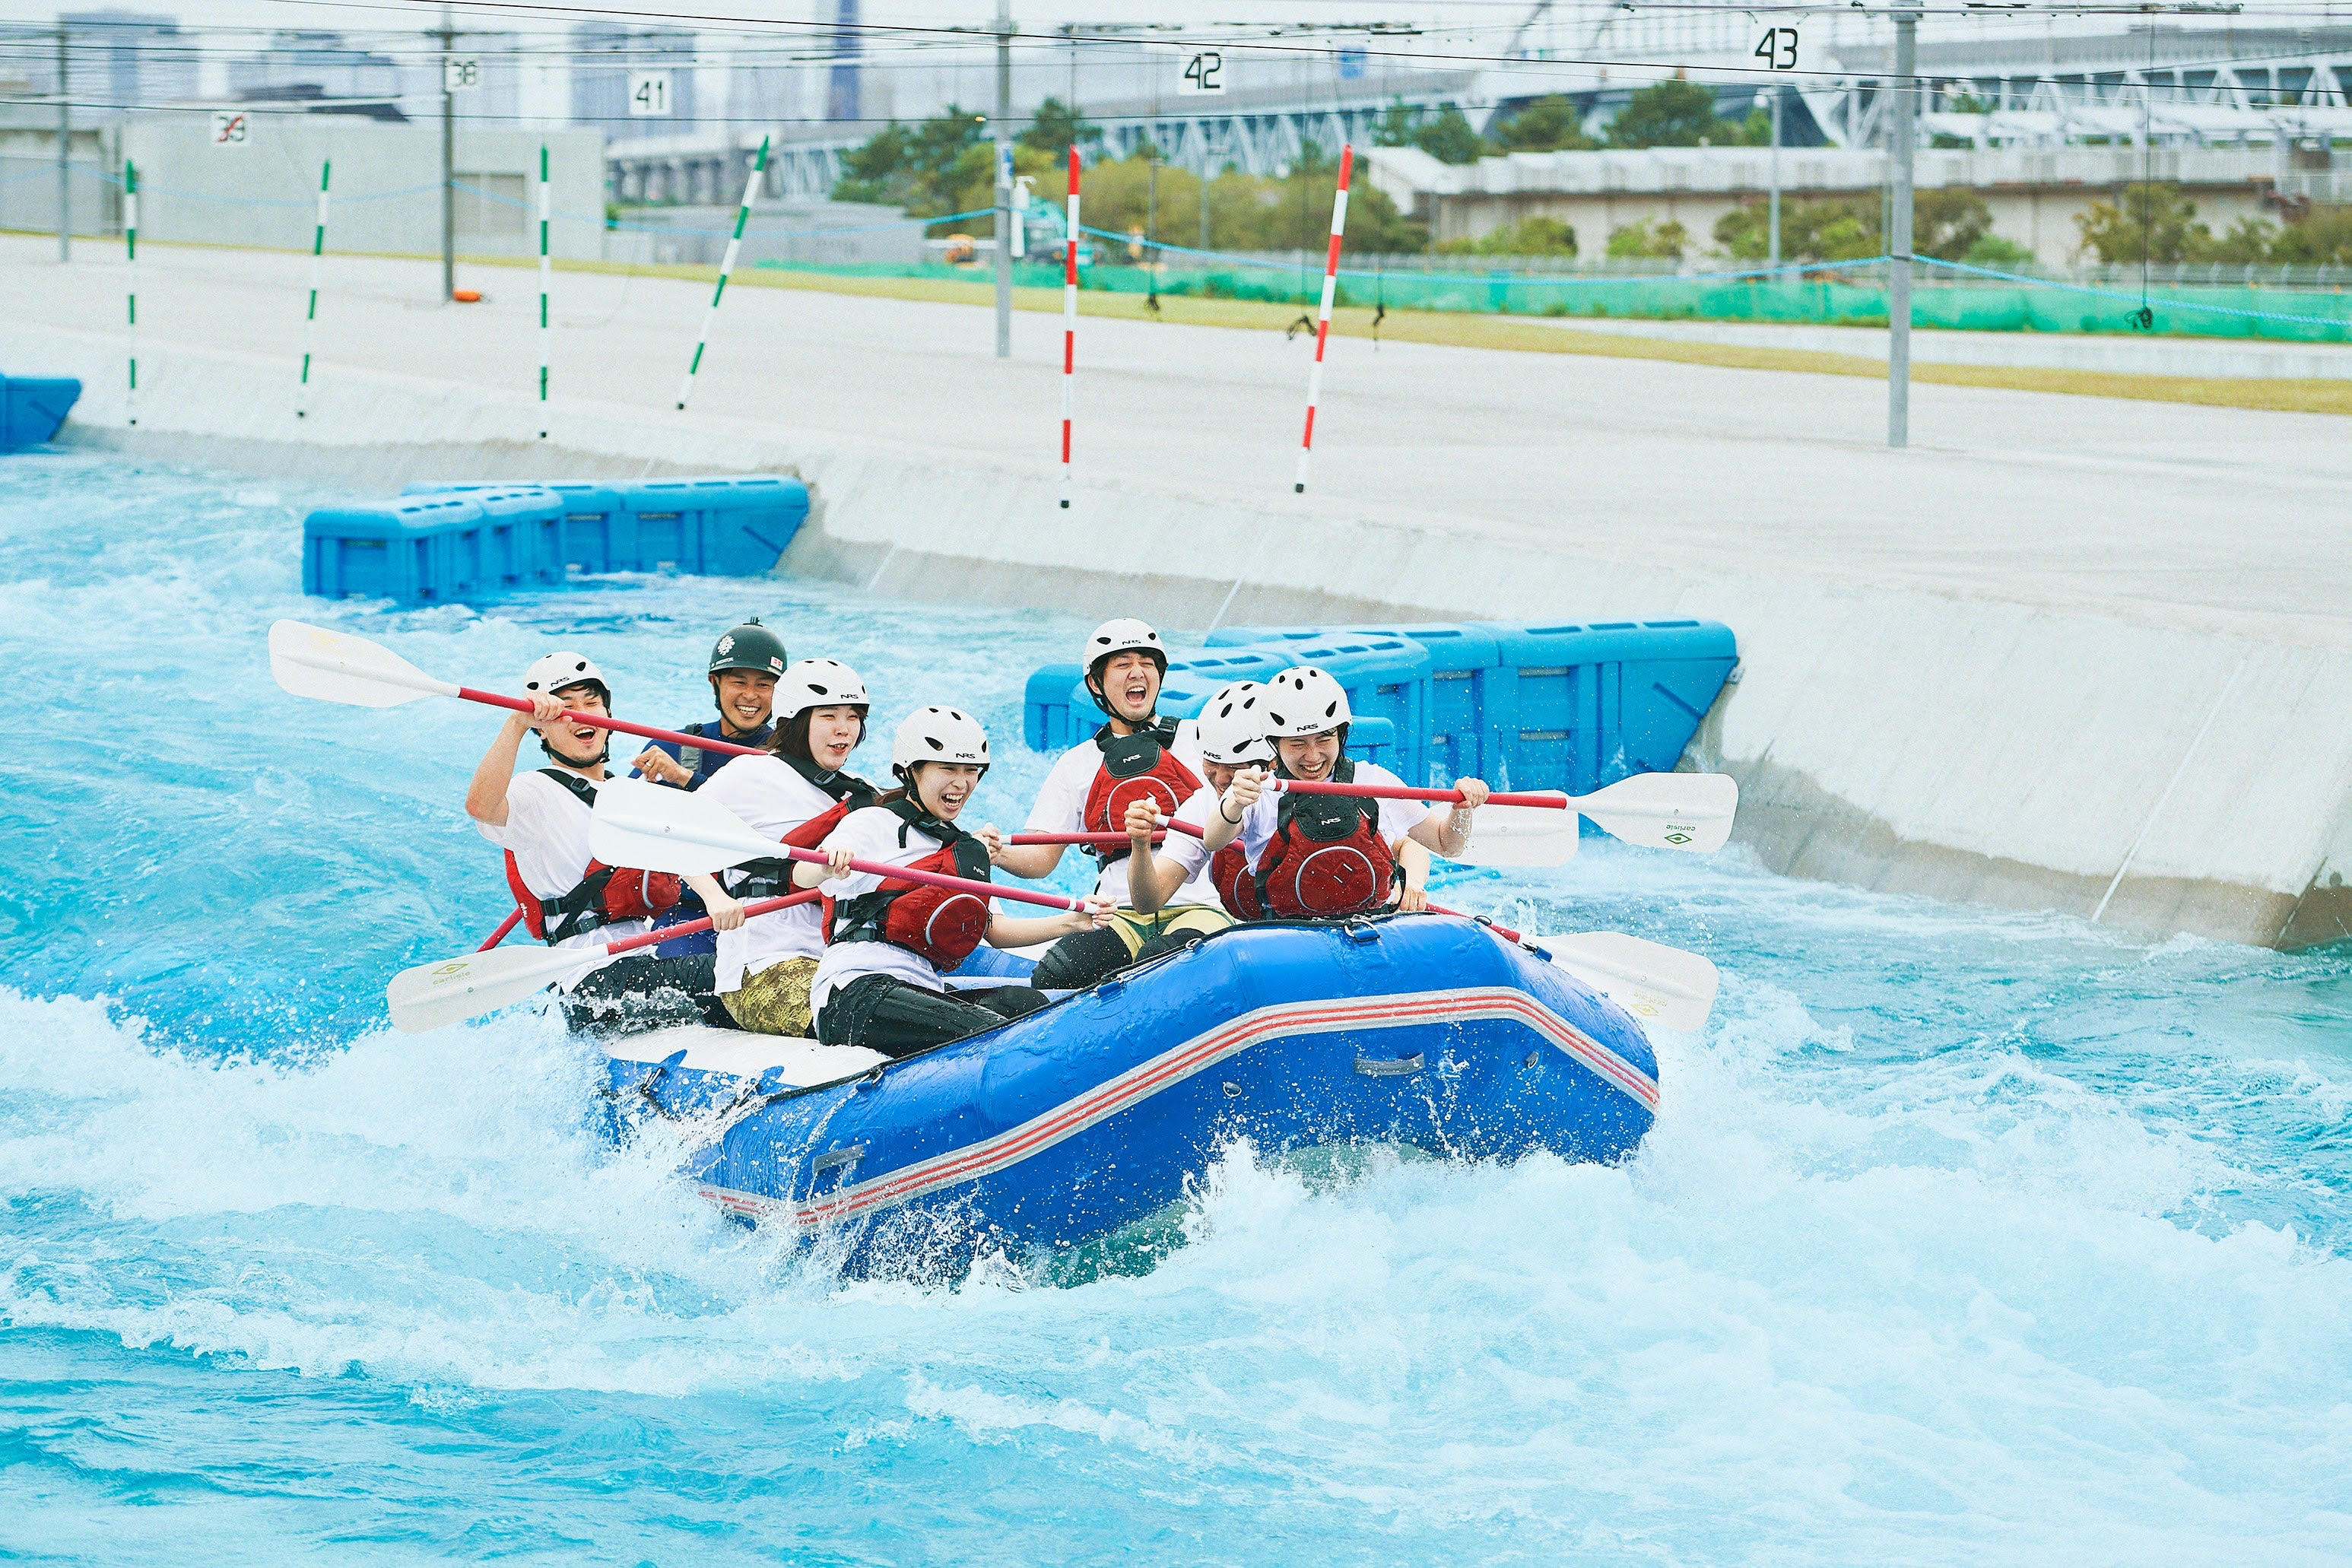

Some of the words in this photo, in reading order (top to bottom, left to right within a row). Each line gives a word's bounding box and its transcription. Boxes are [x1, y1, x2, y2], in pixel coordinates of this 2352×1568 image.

[1755, 27, 1798, 69] 43
[1185, 52, 1221, 90] 42
[636, 81, 662, 110] 41
[550, 676, 570, 687] NRS
[1297, 722, 1319, 732] NRS
[1122, 754, 1142, 763] NRS
[1203, 750, 1222, 760] NRS
[1321, 817, 1341, 826] NRS
[973, 865, 986, 876] NRS
